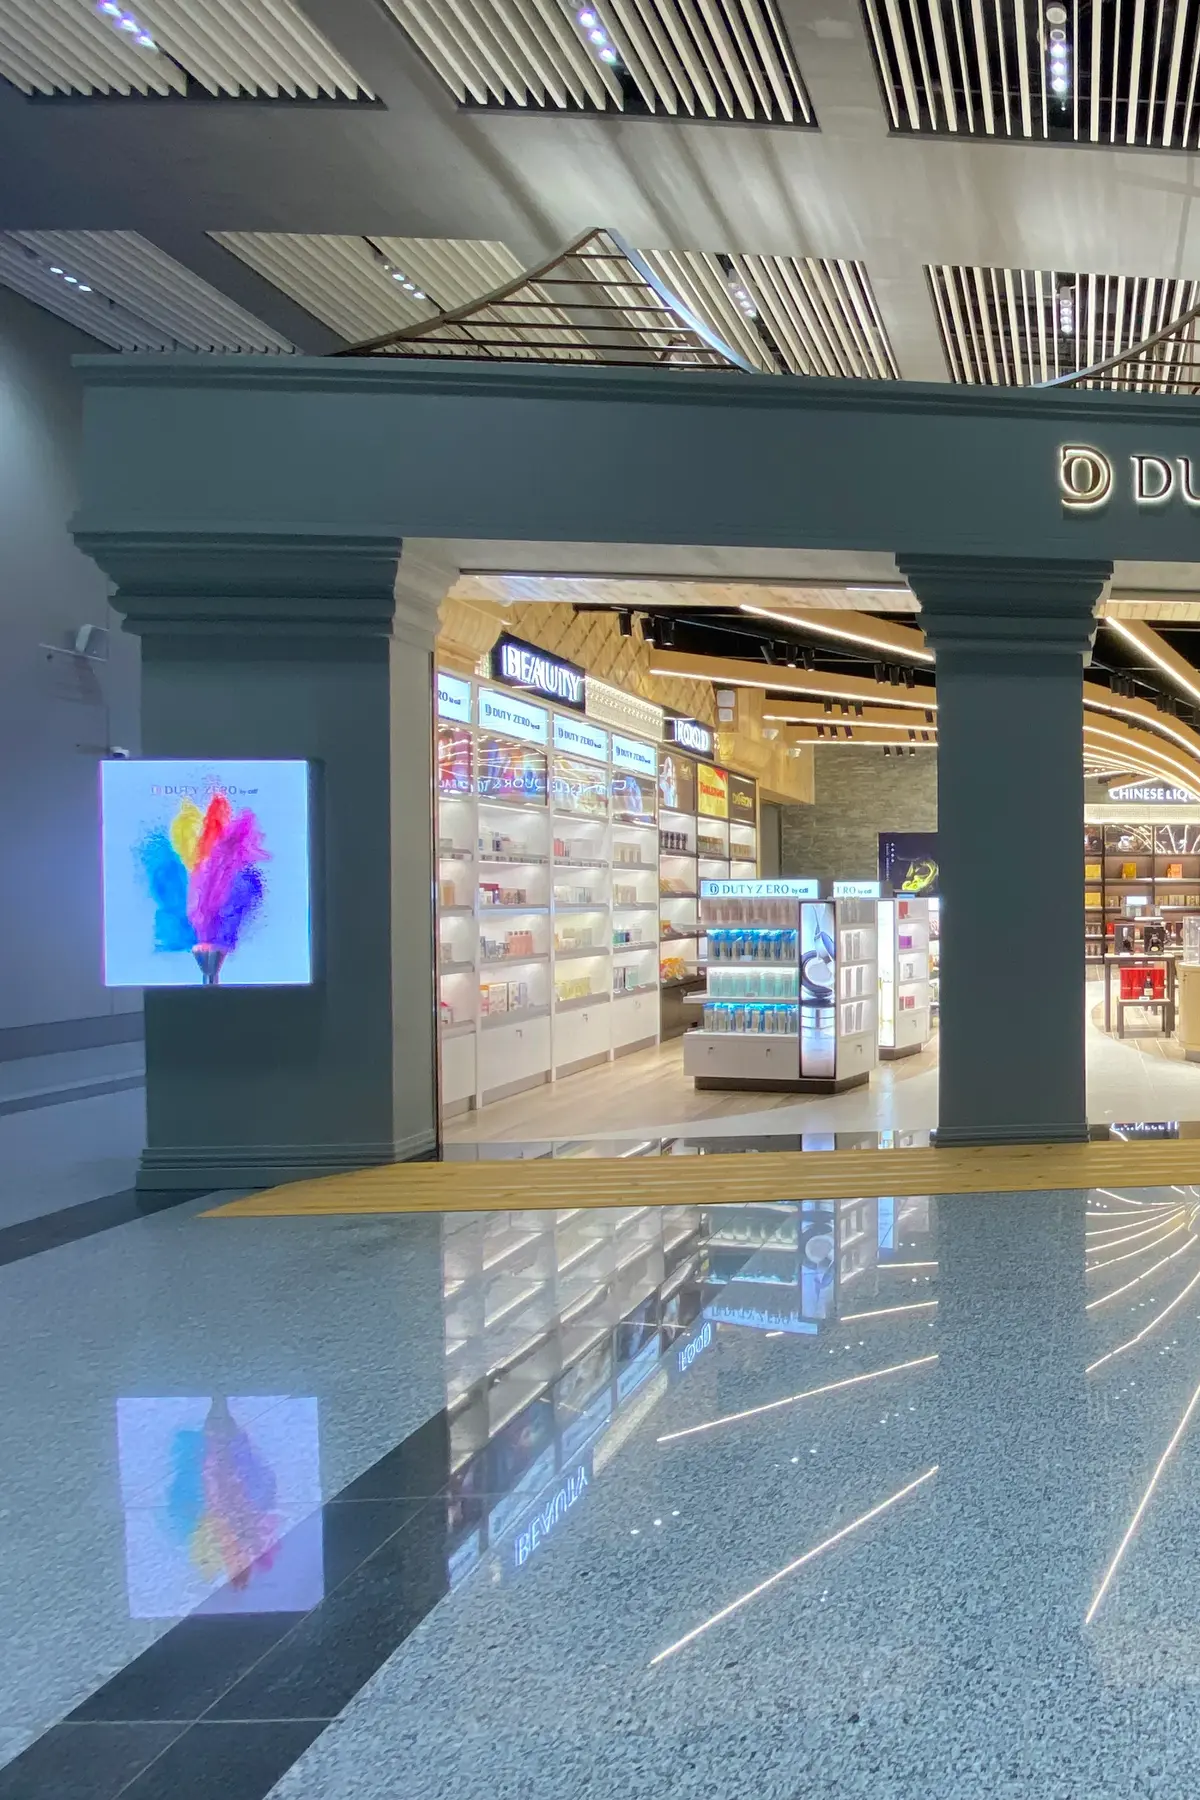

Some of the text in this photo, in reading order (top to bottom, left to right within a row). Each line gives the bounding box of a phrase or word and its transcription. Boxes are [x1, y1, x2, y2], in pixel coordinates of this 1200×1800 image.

[502, 643, 581, 701] BEAUTY
[493, 707, 512, 721] DUTY
[513, 714, 531, 727] ZERO
[165, 785, 198, 795] DUTY
[204, 785, 237, 795] ZERO
[1109, 788, 1164, 800] CHINESE
[722, 885, 753, 895] DUTY
[755, 884, 790, 895] ZERO
